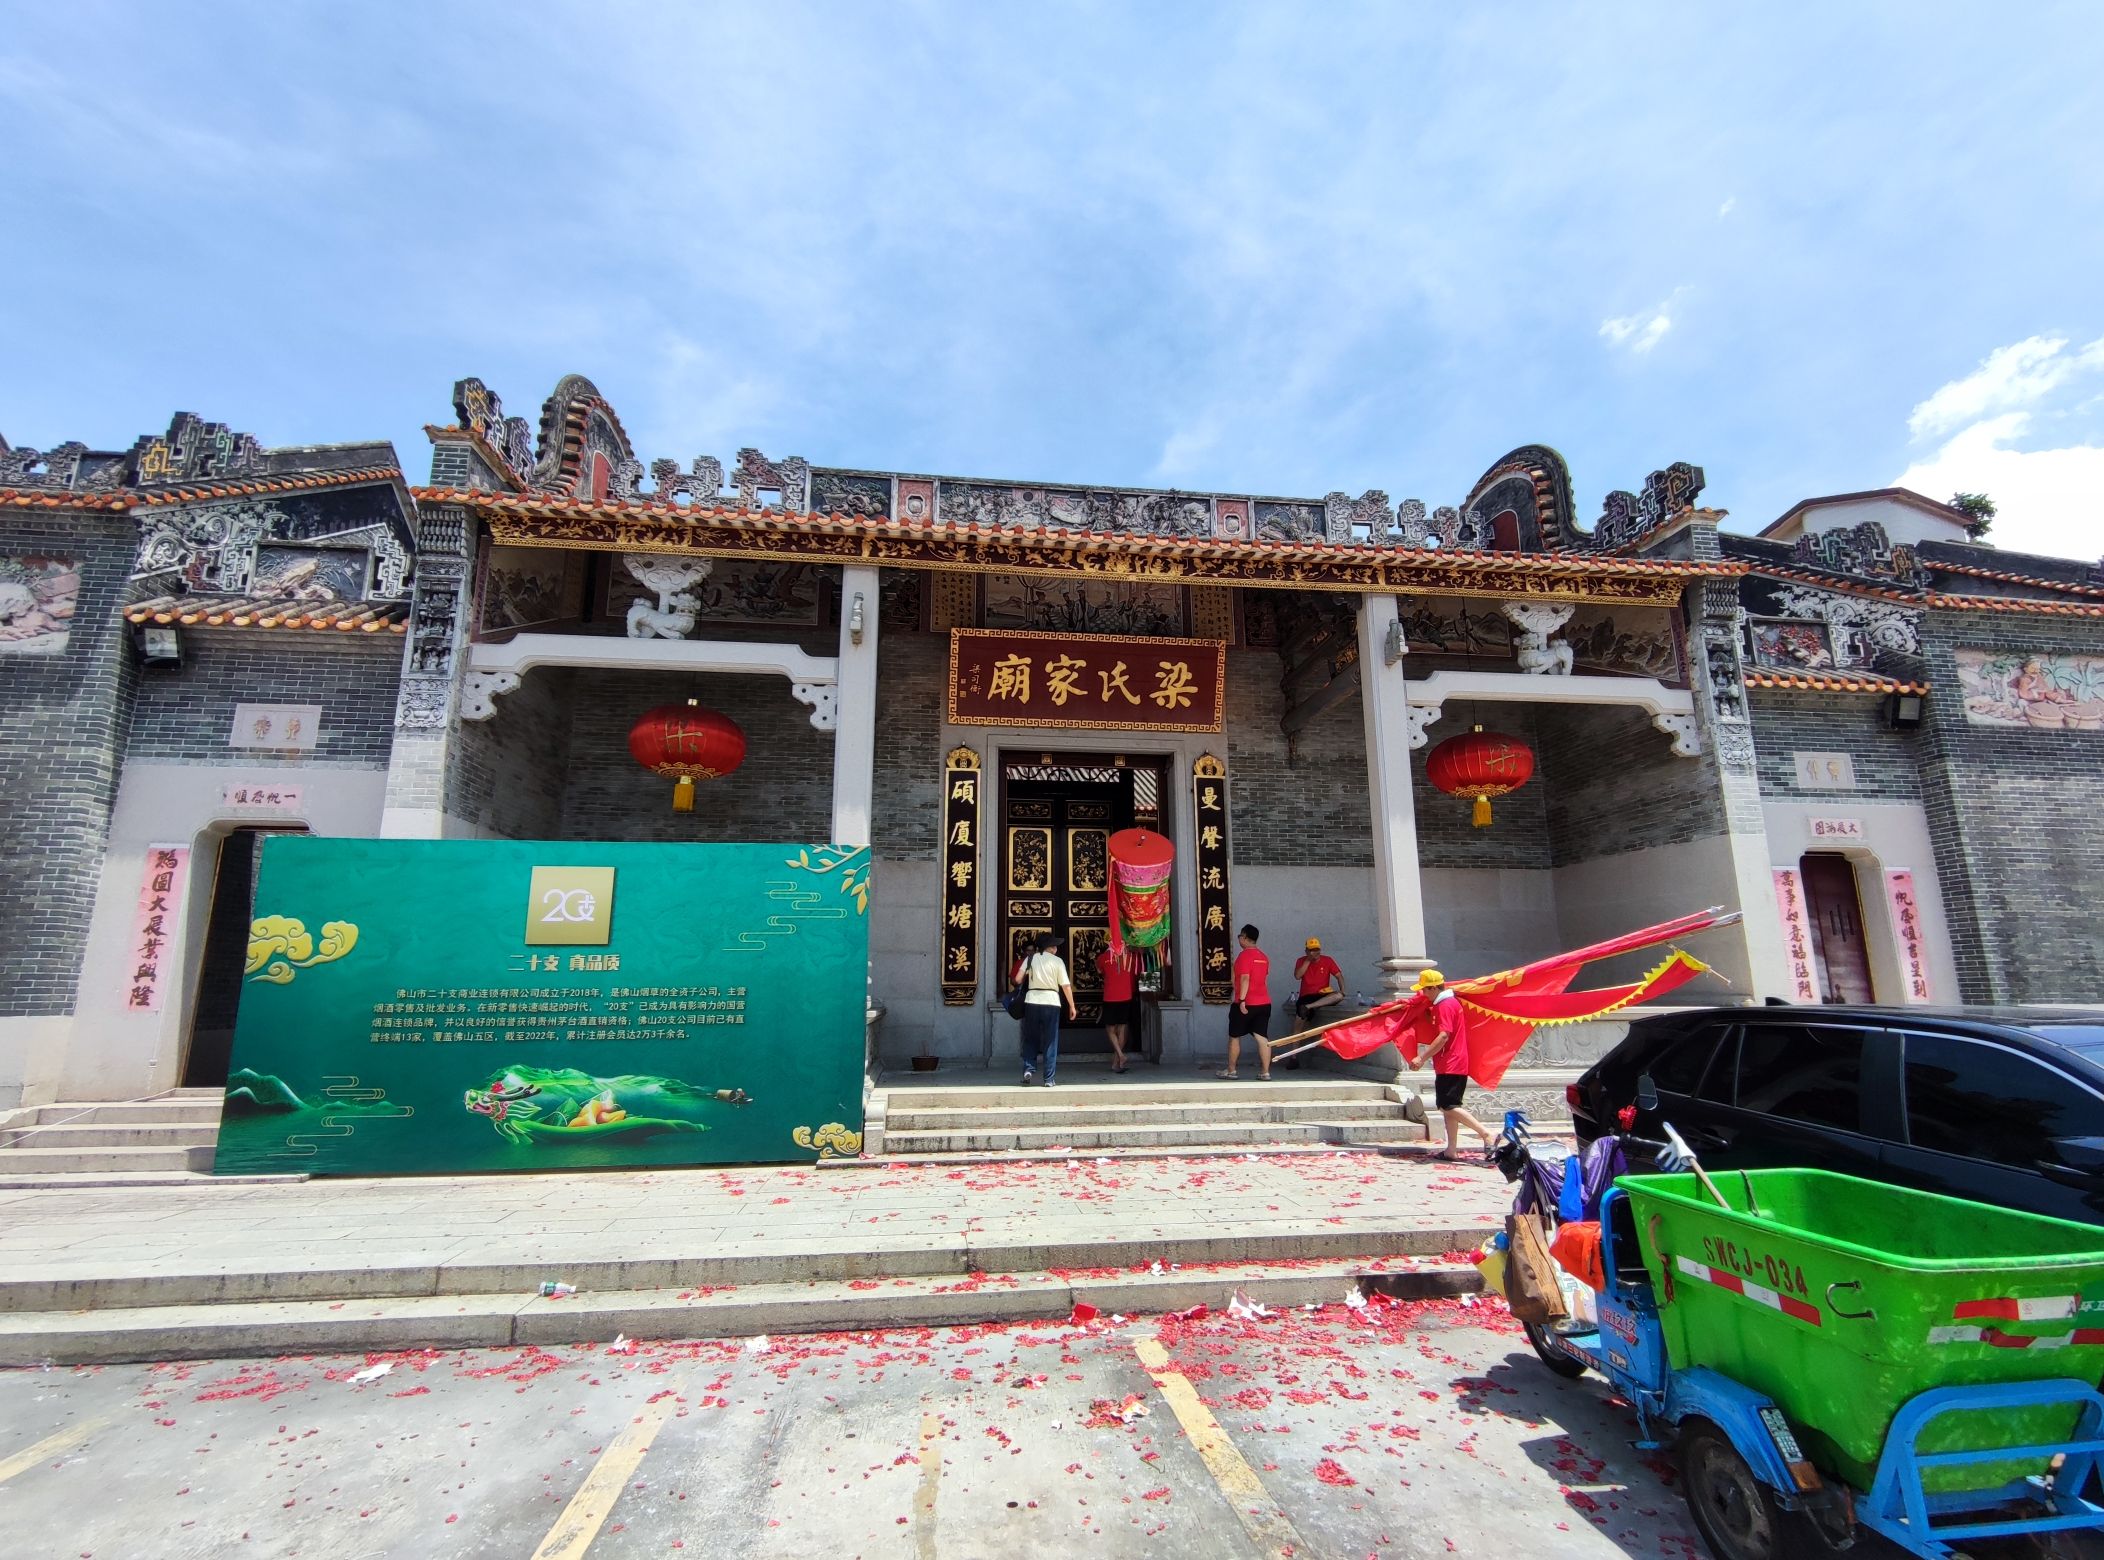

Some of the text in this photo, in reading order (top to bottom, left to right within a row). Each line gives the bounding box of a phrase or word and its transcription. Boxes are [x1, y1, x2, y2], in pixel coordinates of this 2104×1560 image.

[987, 653, 1199, 710] 梁氏家廟
[507, 953, 620, 971] 二十支 真品质
